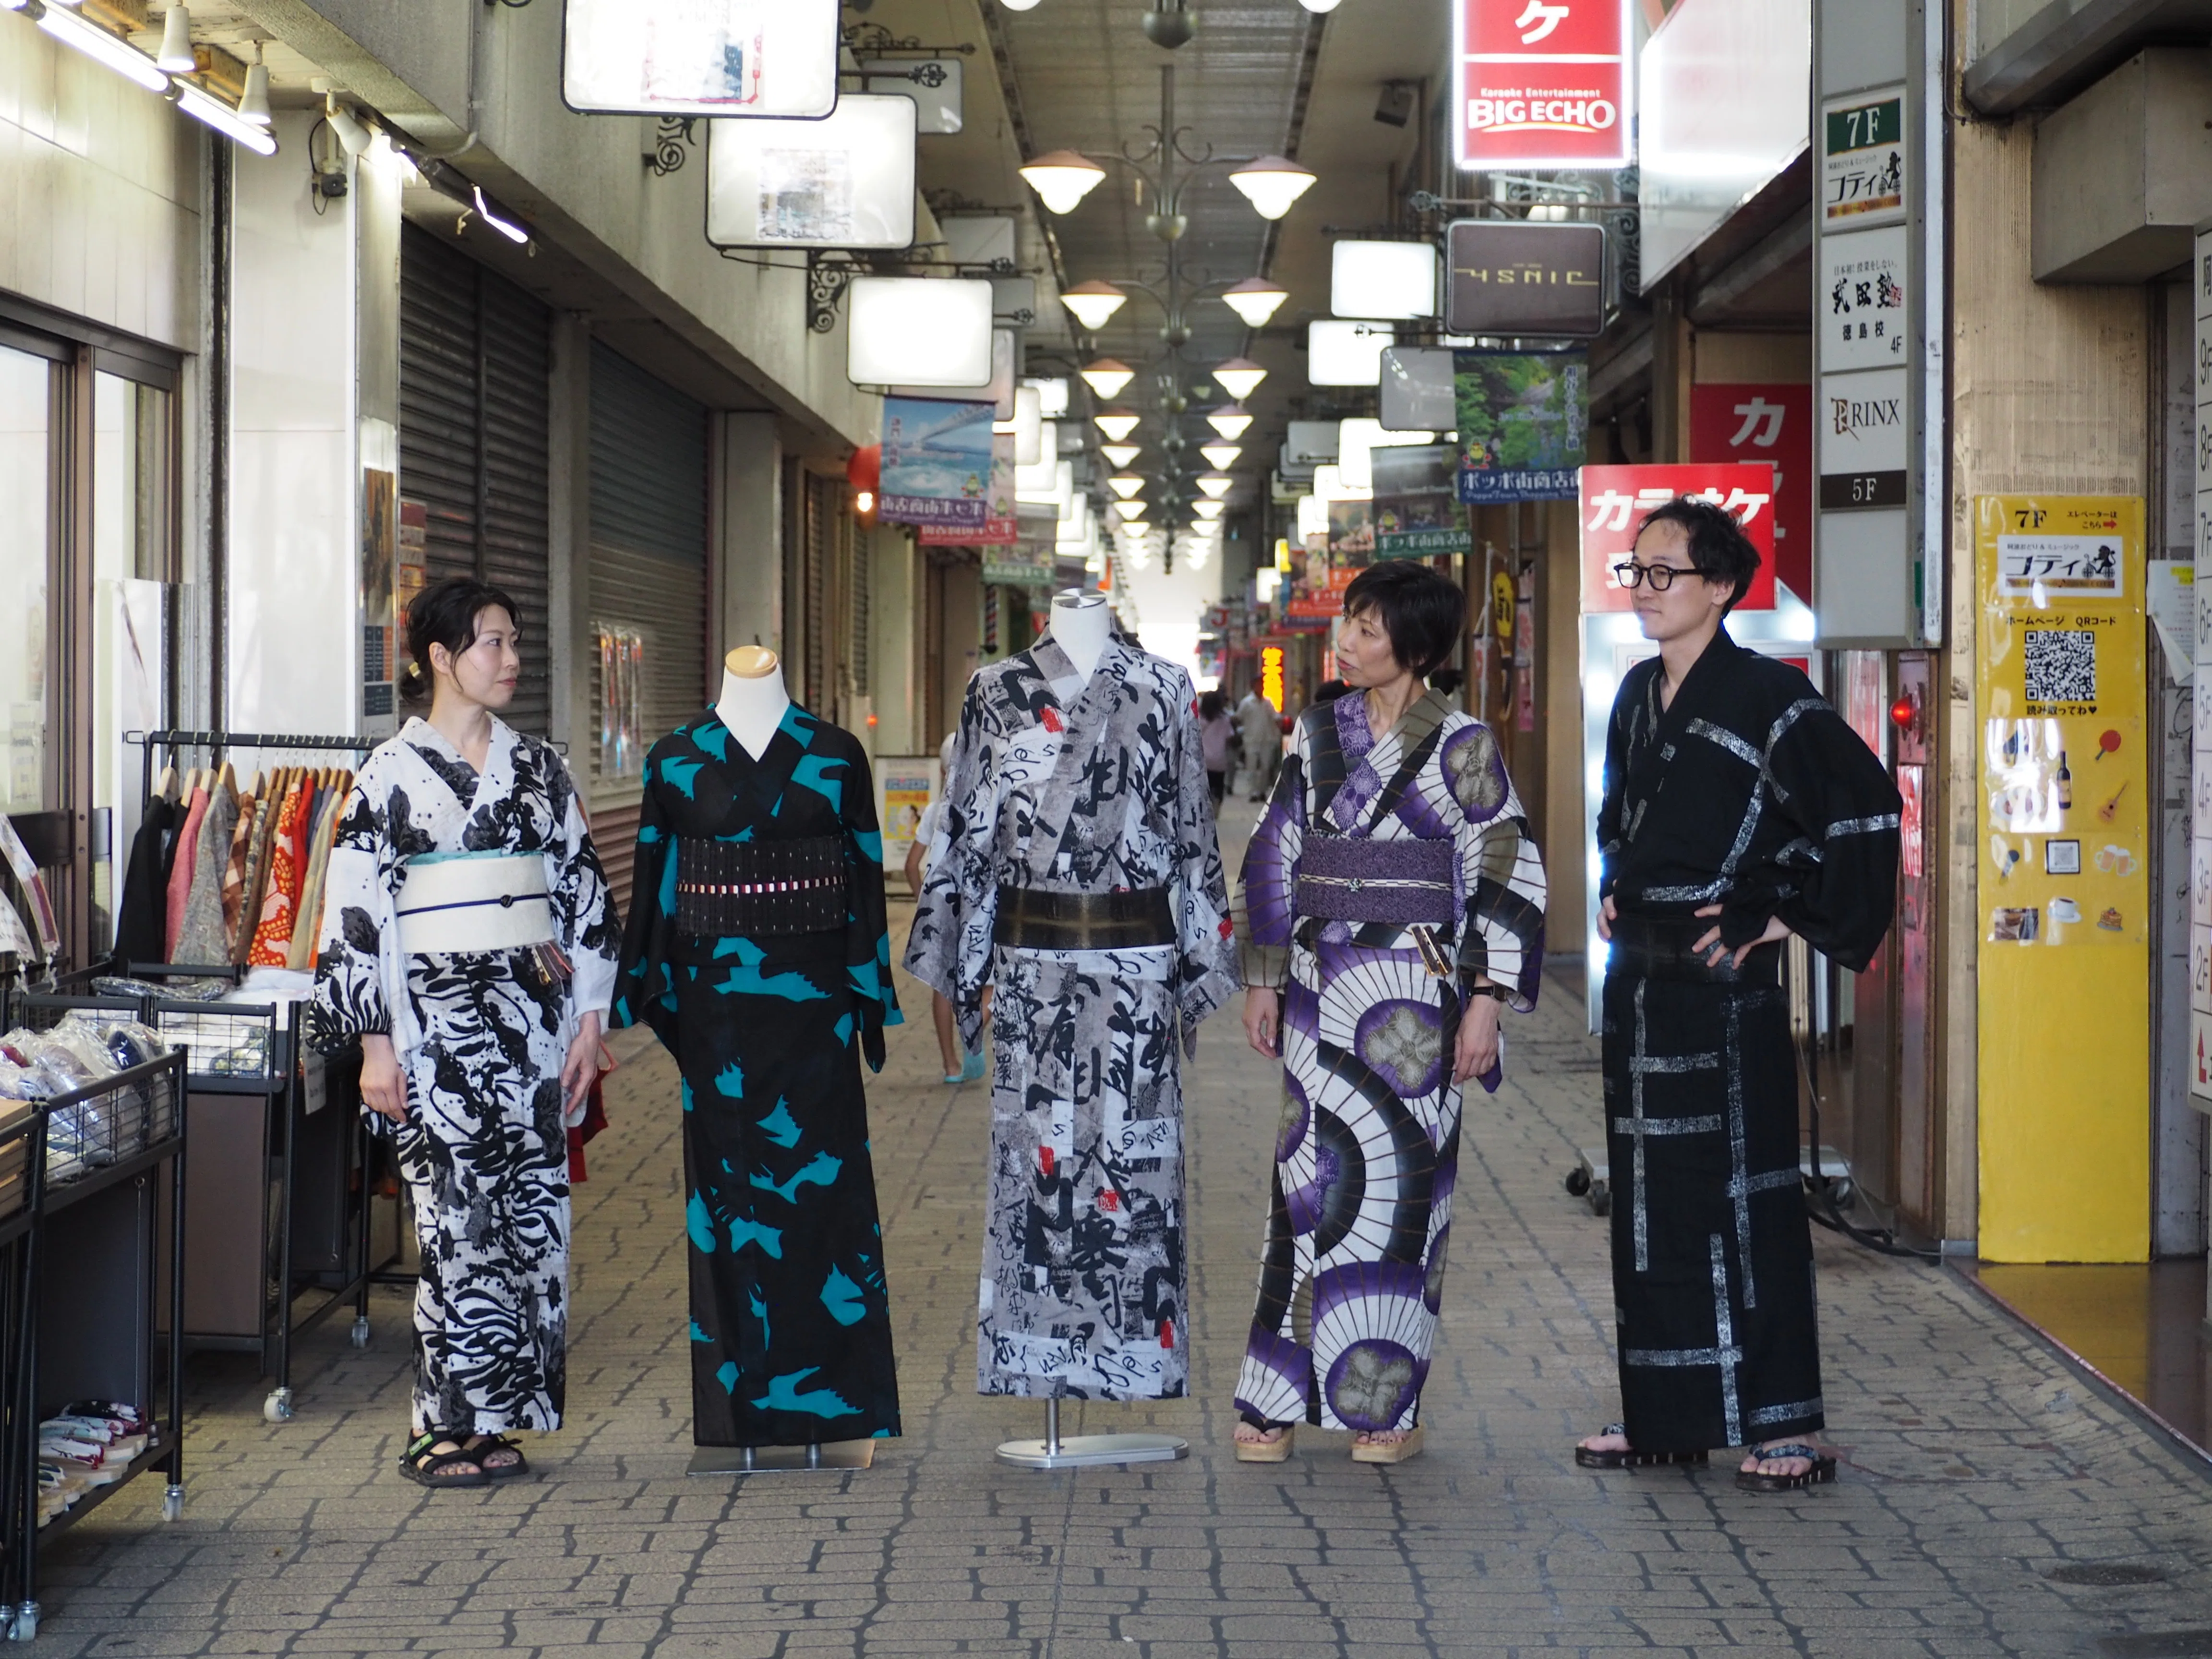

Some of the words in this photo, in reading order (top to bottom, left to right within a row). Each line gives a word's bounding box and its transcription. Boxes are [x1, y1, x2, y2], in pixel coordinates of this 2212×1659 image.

[1481, 87, 1522, 98] Karaoke
[1526, 87, 1600, 98] Entertainment
[1468, 99, 1526, 129] BIG
[1531, 99, 1616, 129] ECHO
[1847, 107, 1880, 147] 7F
[1842, 320, 1884, 341] 徳島校
[1890, 335, 1902, 354] 4F
[1851, 398, 1900, 428] RINX
[1852, 478, 1877, 502] 5F
[2015, 509, 2047, 528] 7F
[2082, 521, 2102, 529] こちら
[2200, 512, 2212, 557] 7F
[2006, 616, 2065, 625] ホームページ
[2075, 616, 2116, 626] QRコード
[2200, 598, 2212, 645] 6F
[2199, 684, 2211, 731] 5F
[2198, 771, 2211, 818] 4F
[2197, 857, 2209, 905] 3F
[2196, 945, 2208, 992] 2F
